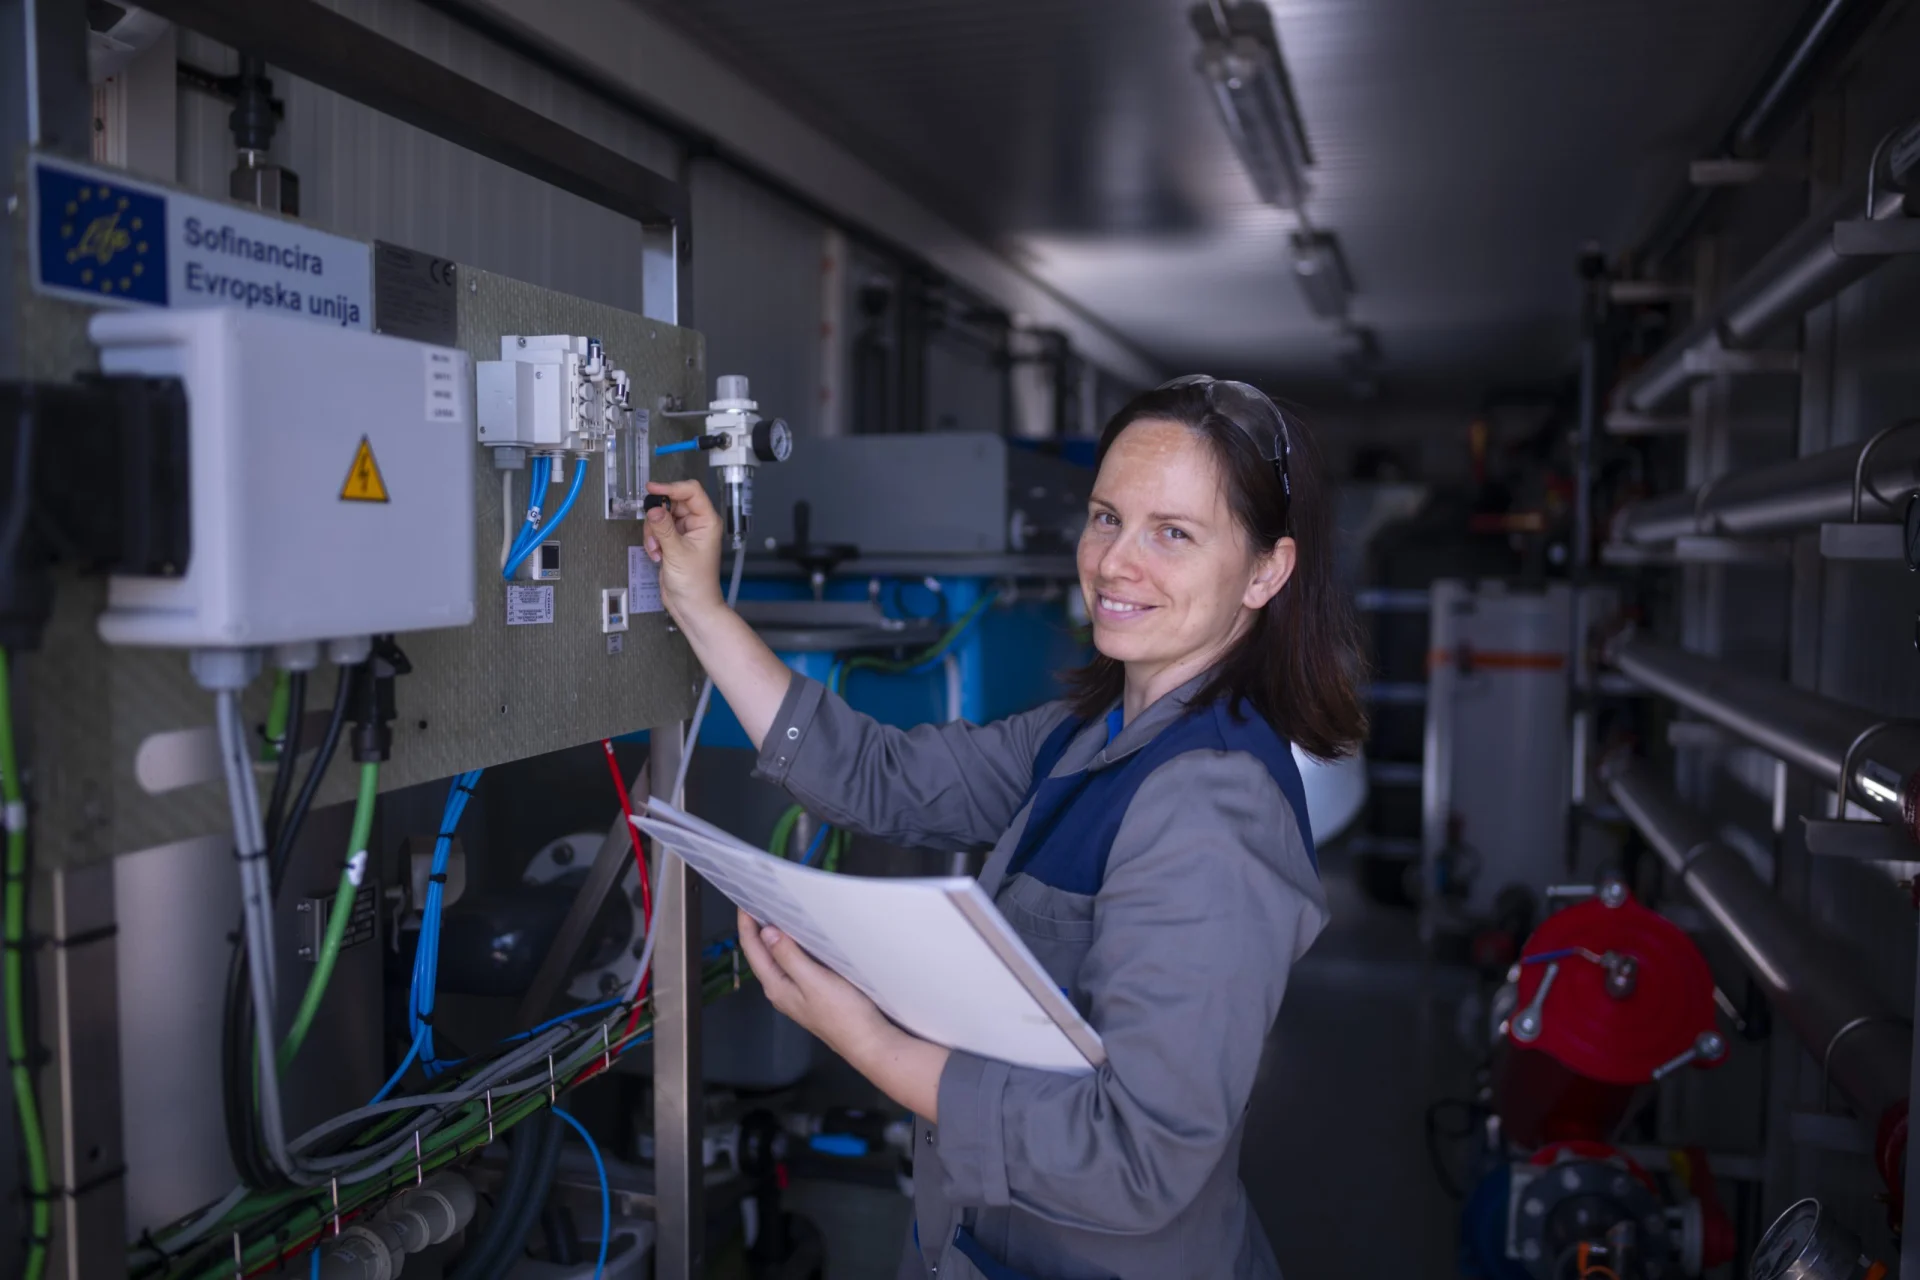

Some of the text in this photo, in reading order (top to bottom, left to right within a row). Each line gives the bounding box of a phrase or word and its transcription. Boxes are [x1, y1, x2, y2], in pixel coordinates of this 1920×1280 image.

[185, 217, 323, 276] Sofinancira
[186, 261, 361, 327] Evropska unija
[530, 510, 538, 518] G
